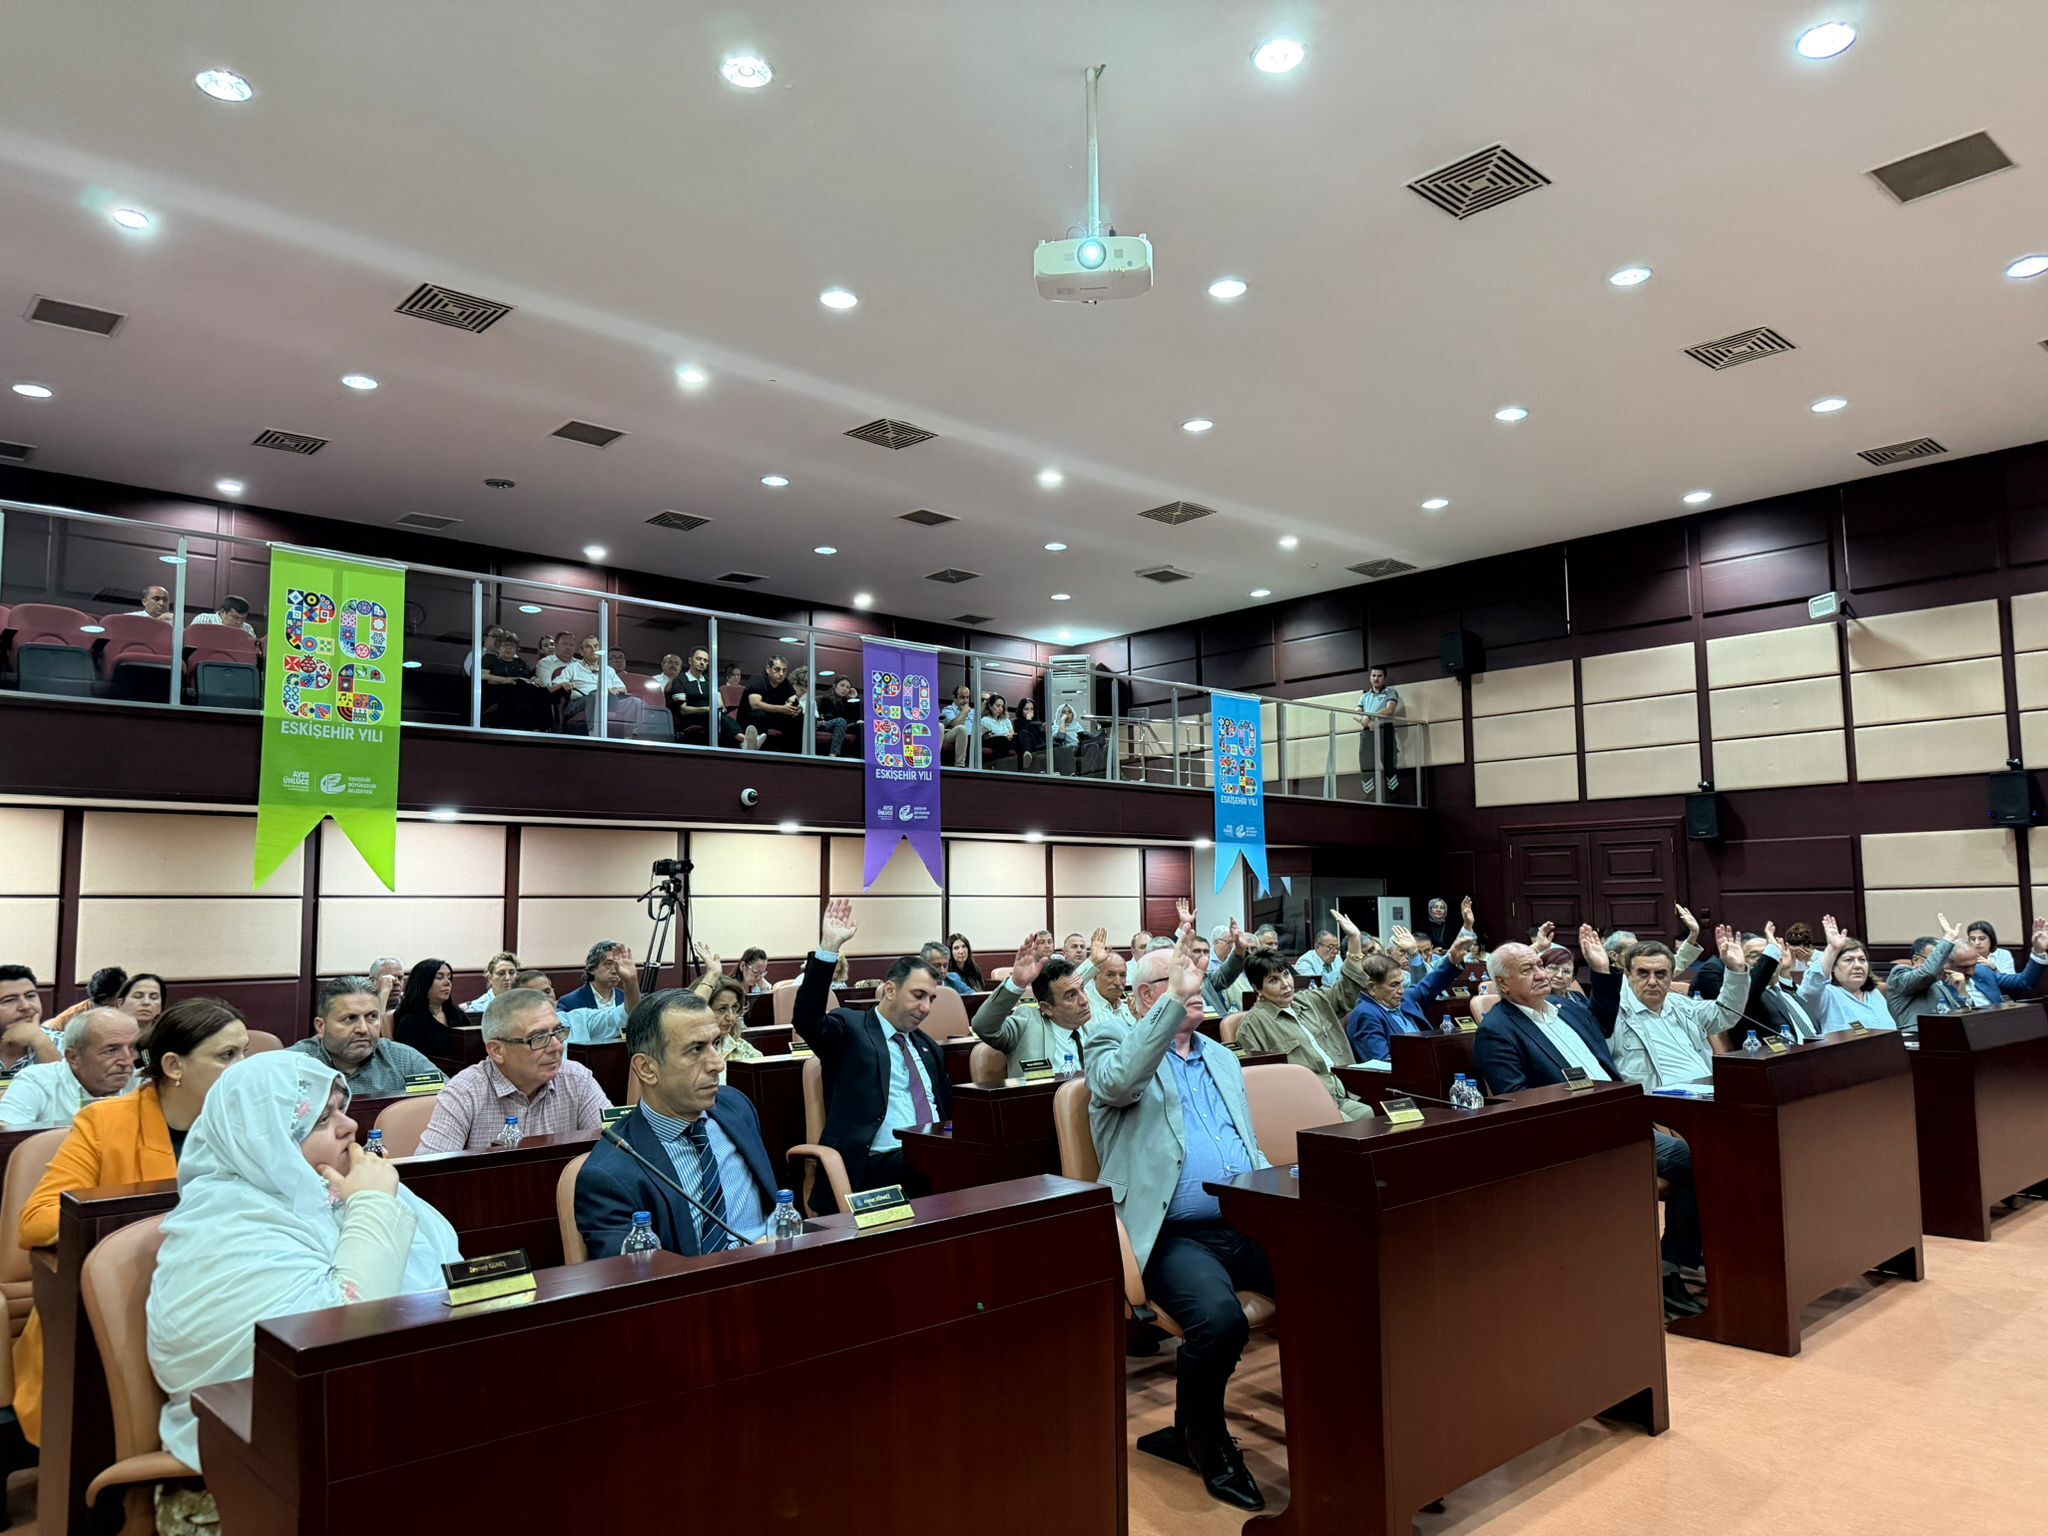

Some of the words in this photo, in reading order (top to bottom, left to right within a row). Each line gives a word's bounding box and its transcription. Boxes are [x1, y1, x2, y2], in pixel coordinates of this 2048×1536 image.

[280, 720, 355, 740] ESKİŞEHİR
[358, 728, 384, 743] YILI
[875, 767, 917, 781] ESKİŞEHİR
[918, 770, 932, 781] YILI
